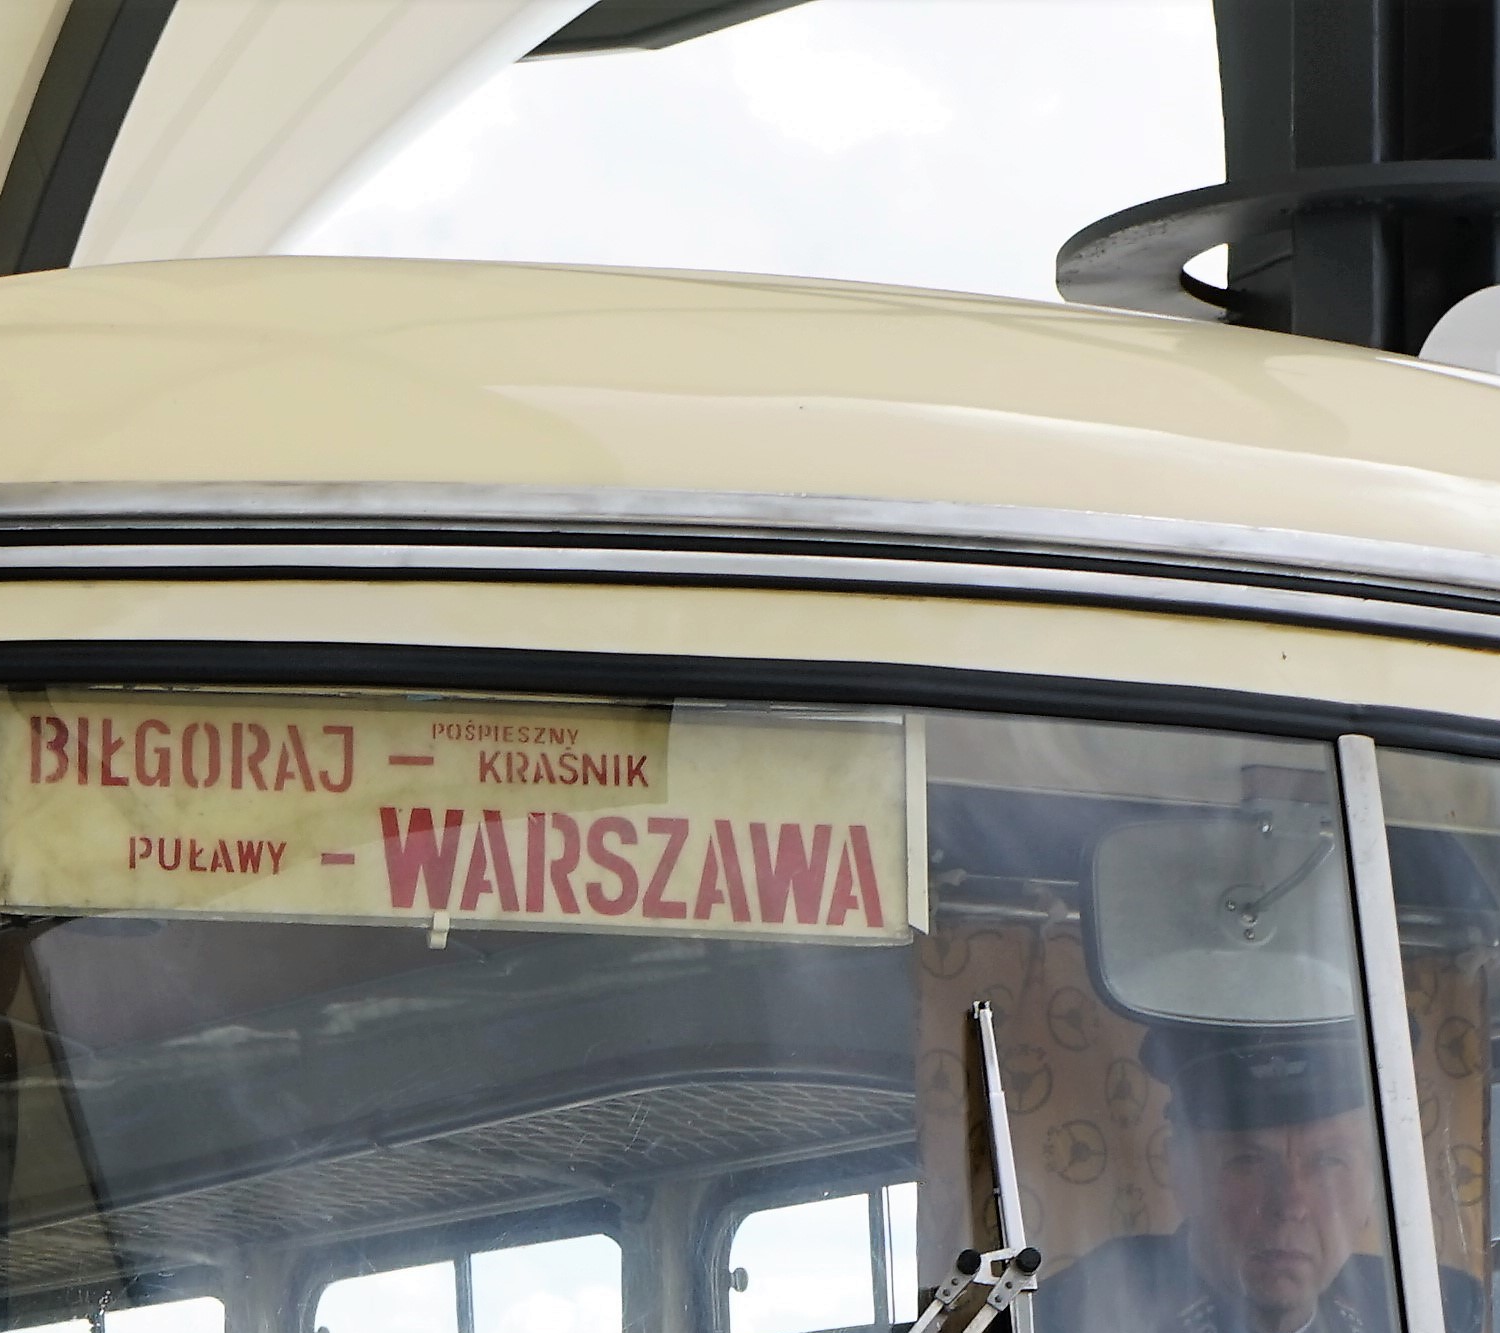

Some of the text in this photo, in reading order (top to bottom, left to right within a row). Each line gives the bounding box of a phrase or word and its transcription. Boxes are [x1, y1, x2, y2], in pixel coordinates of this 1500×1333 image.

[29, 716, 355, 794] BIŁGORAJ
[478, 746, 650, 789] KRAŚNIK
[431, 719, 580, 746] POŚPIESZNY
[128, 835, 288, 876] PUŁAWY
[379, 806, 886, 929] WARSZAWA
